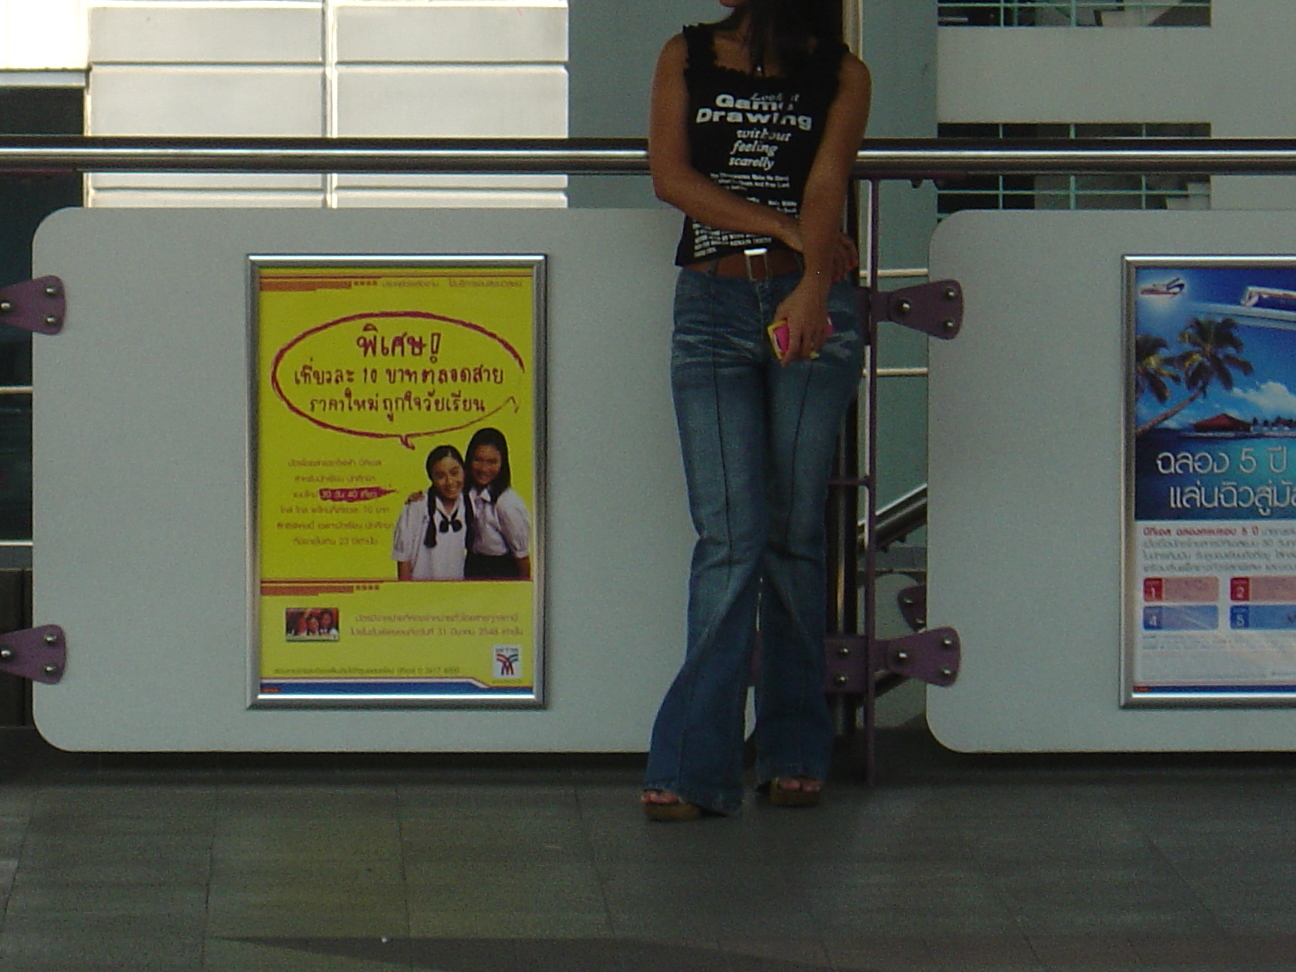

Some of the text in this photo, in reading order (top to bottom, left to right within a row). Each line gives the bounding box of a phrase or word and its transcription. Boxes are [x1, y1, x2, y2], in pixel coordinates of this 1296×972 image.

[696, 108, 813, 131] Drawing
[736, 127, 792, 142] without
[730, 139, 779, 157] feeling
[1156, 444, 1287, 475] ฉลอง 5 ปี
